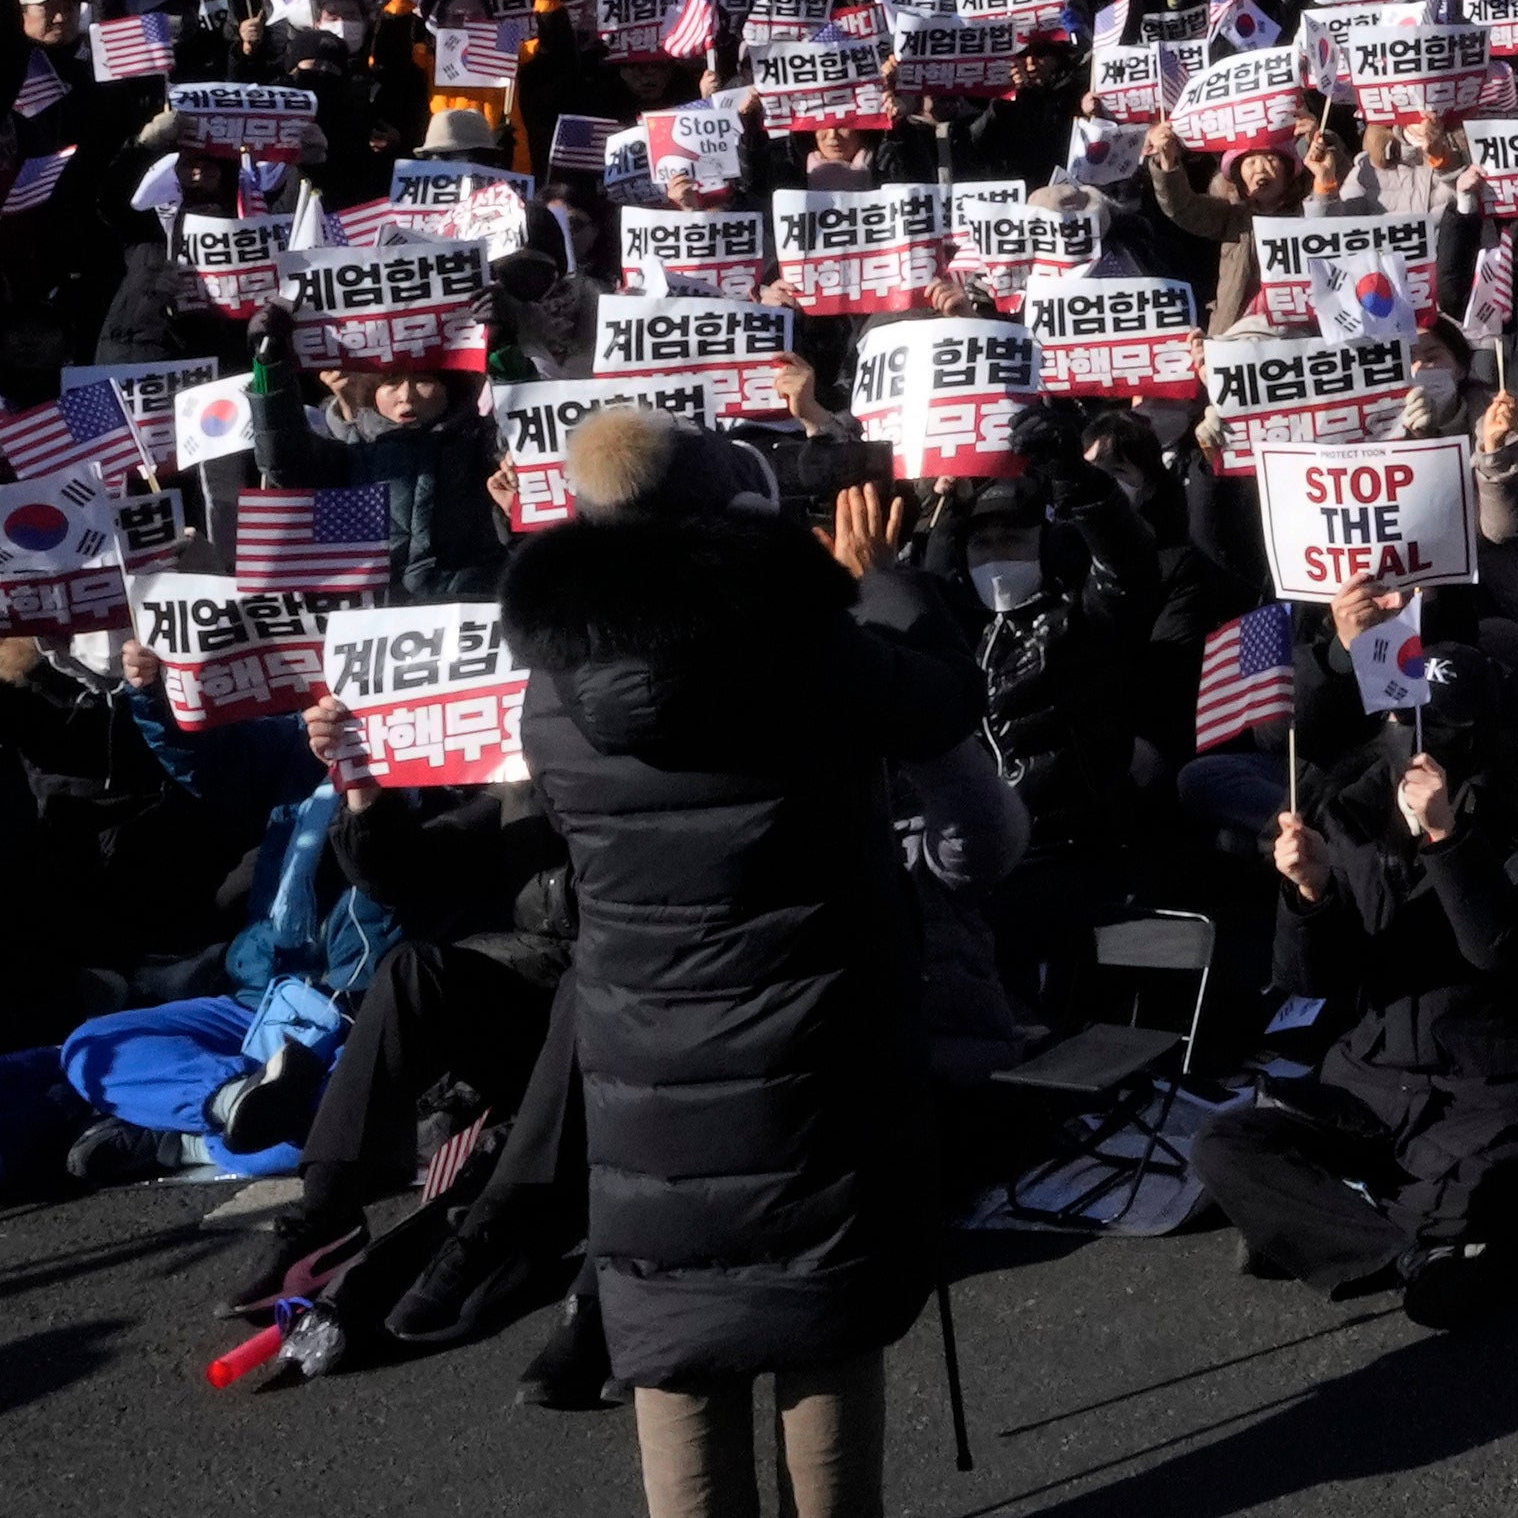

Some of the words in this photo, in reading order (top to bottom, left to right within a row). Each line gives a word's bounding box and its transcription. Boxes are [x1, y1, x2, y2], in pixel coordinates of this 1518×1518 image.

[903, 22, 1013, 57] 계엄합법
[1357, 31, 1487, 75] 계엄합법
[763, 47, 880, 84] 계엄합법
[174, 88, 313, 112] 계엄합법
[1172, 95, 1297, 150] 탄핵무효
[1359, 77, 1480, 123] 탄핵무효
[680, 116, 732, 138] Stop
[700, 140, 728, 152] the
[626, 220, 758, 260] 계엄합법
[781, 194, 934, 250] 계엄합법
[290, 250, 483, 312] 계엄합법
[782, 248, 937, 305] 탄핵무효
[1032, 289, 1193, 338] 계엄합법
[604, 312, 784, 362] 계엄합법
[1041, 340, 1195, 386] 탄핵무효
[1213, 345, 1400, 407] 계엄합법
[1304, 541, 1432, 583] STEAL
